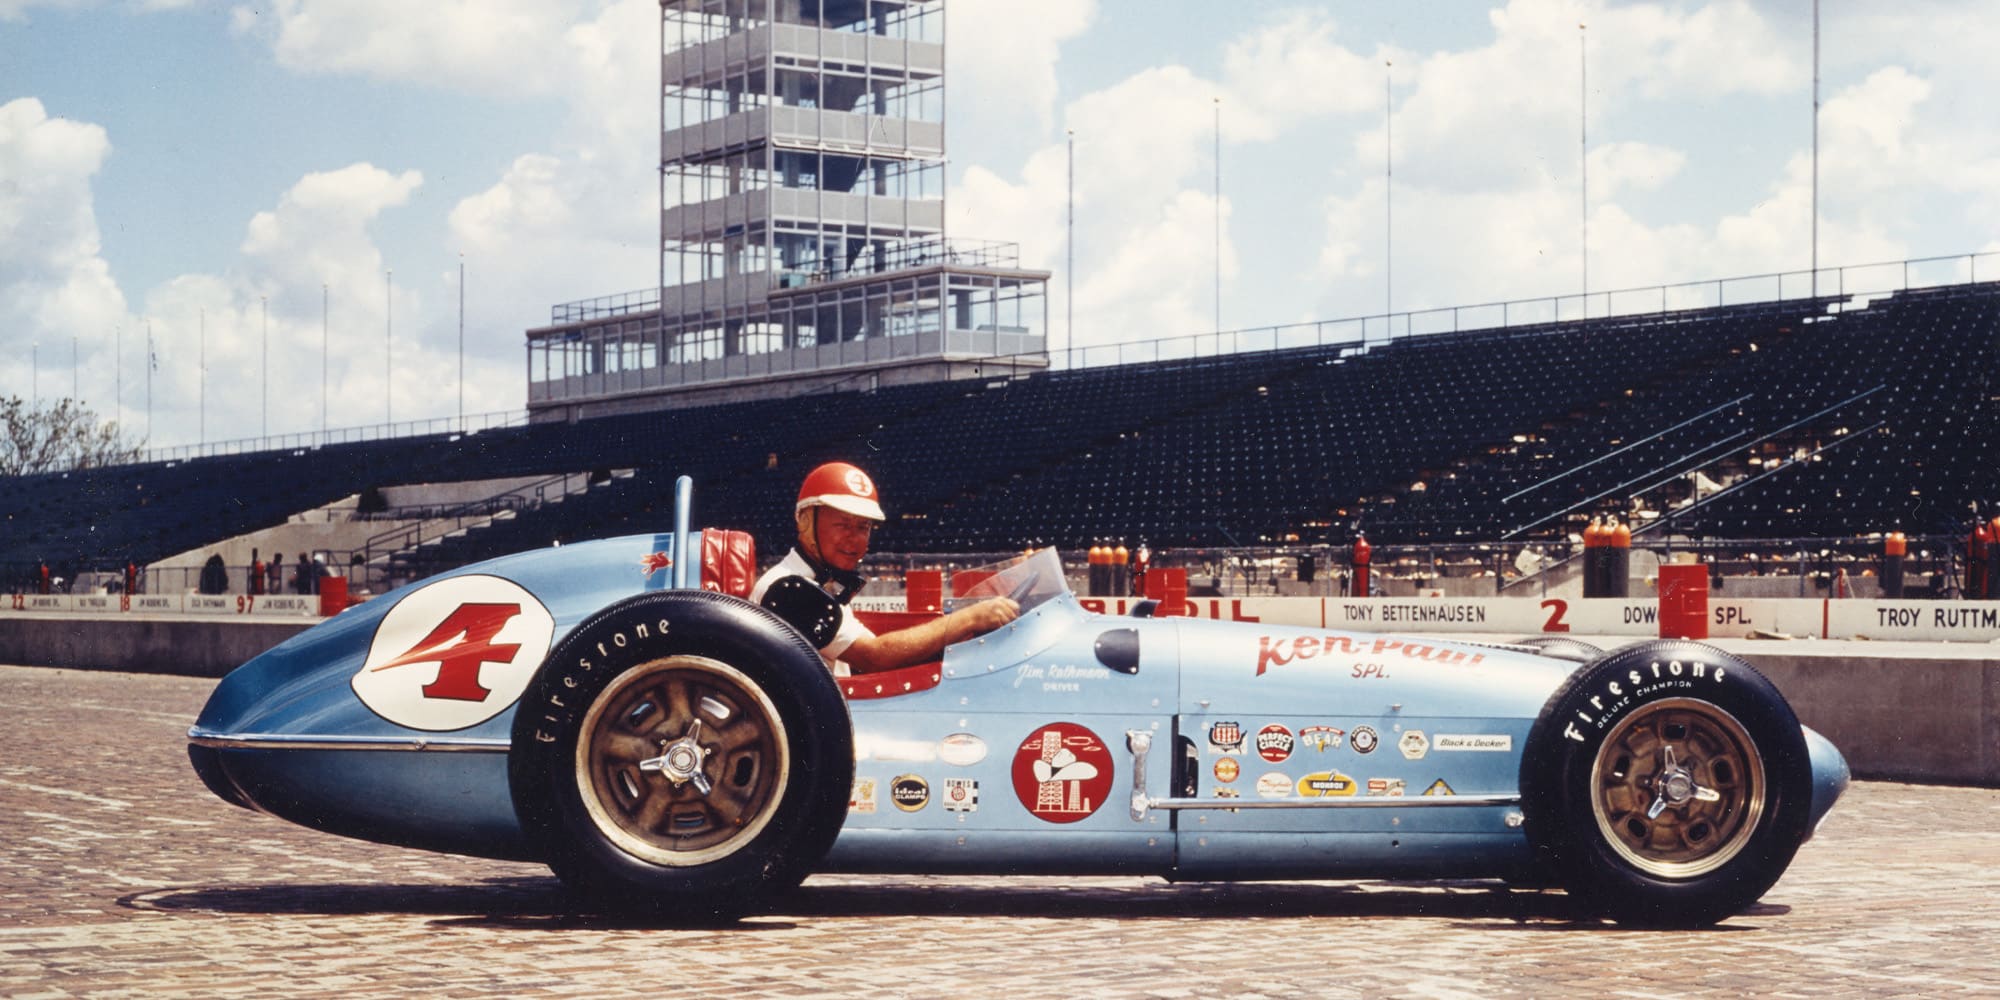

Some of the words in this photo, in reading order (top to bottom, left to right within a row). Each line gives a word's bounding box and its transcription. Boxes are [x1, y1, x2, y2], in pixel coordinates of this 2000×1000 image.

[851, 474, 868, 493] 4
[237, 595, 254, 613] 97
[1344, 605, 1373, 621] TONY
[1382, 605, 1486, 622] BETTENHAUSEN
[1541, 599, 1570, 633] 2
[1715, 607, 1752, 624] SPL.
[1877, 608, 1921, 627] TROY
[1935, 608, 2000, 628] RUTTM
[371, 603, 522, 702] 4
[1013, 664, 1044, 688] Jim
[1351, 663, 1390, 678] SPL.
[536, 619, 670, 742] Firestone
[1043, 682, 1080, 692] DRIVER
[1564, 660, 1726, 742] Firestone
[1597, 696, 1630, 729] DELUXE
[1636, 681, 1693, 697] CHAMPION
[1301, 732, 1342, 747] BEAR
[1440, 738, 1464, 747] Black
[1474, 739, 1506, 747] Decker
